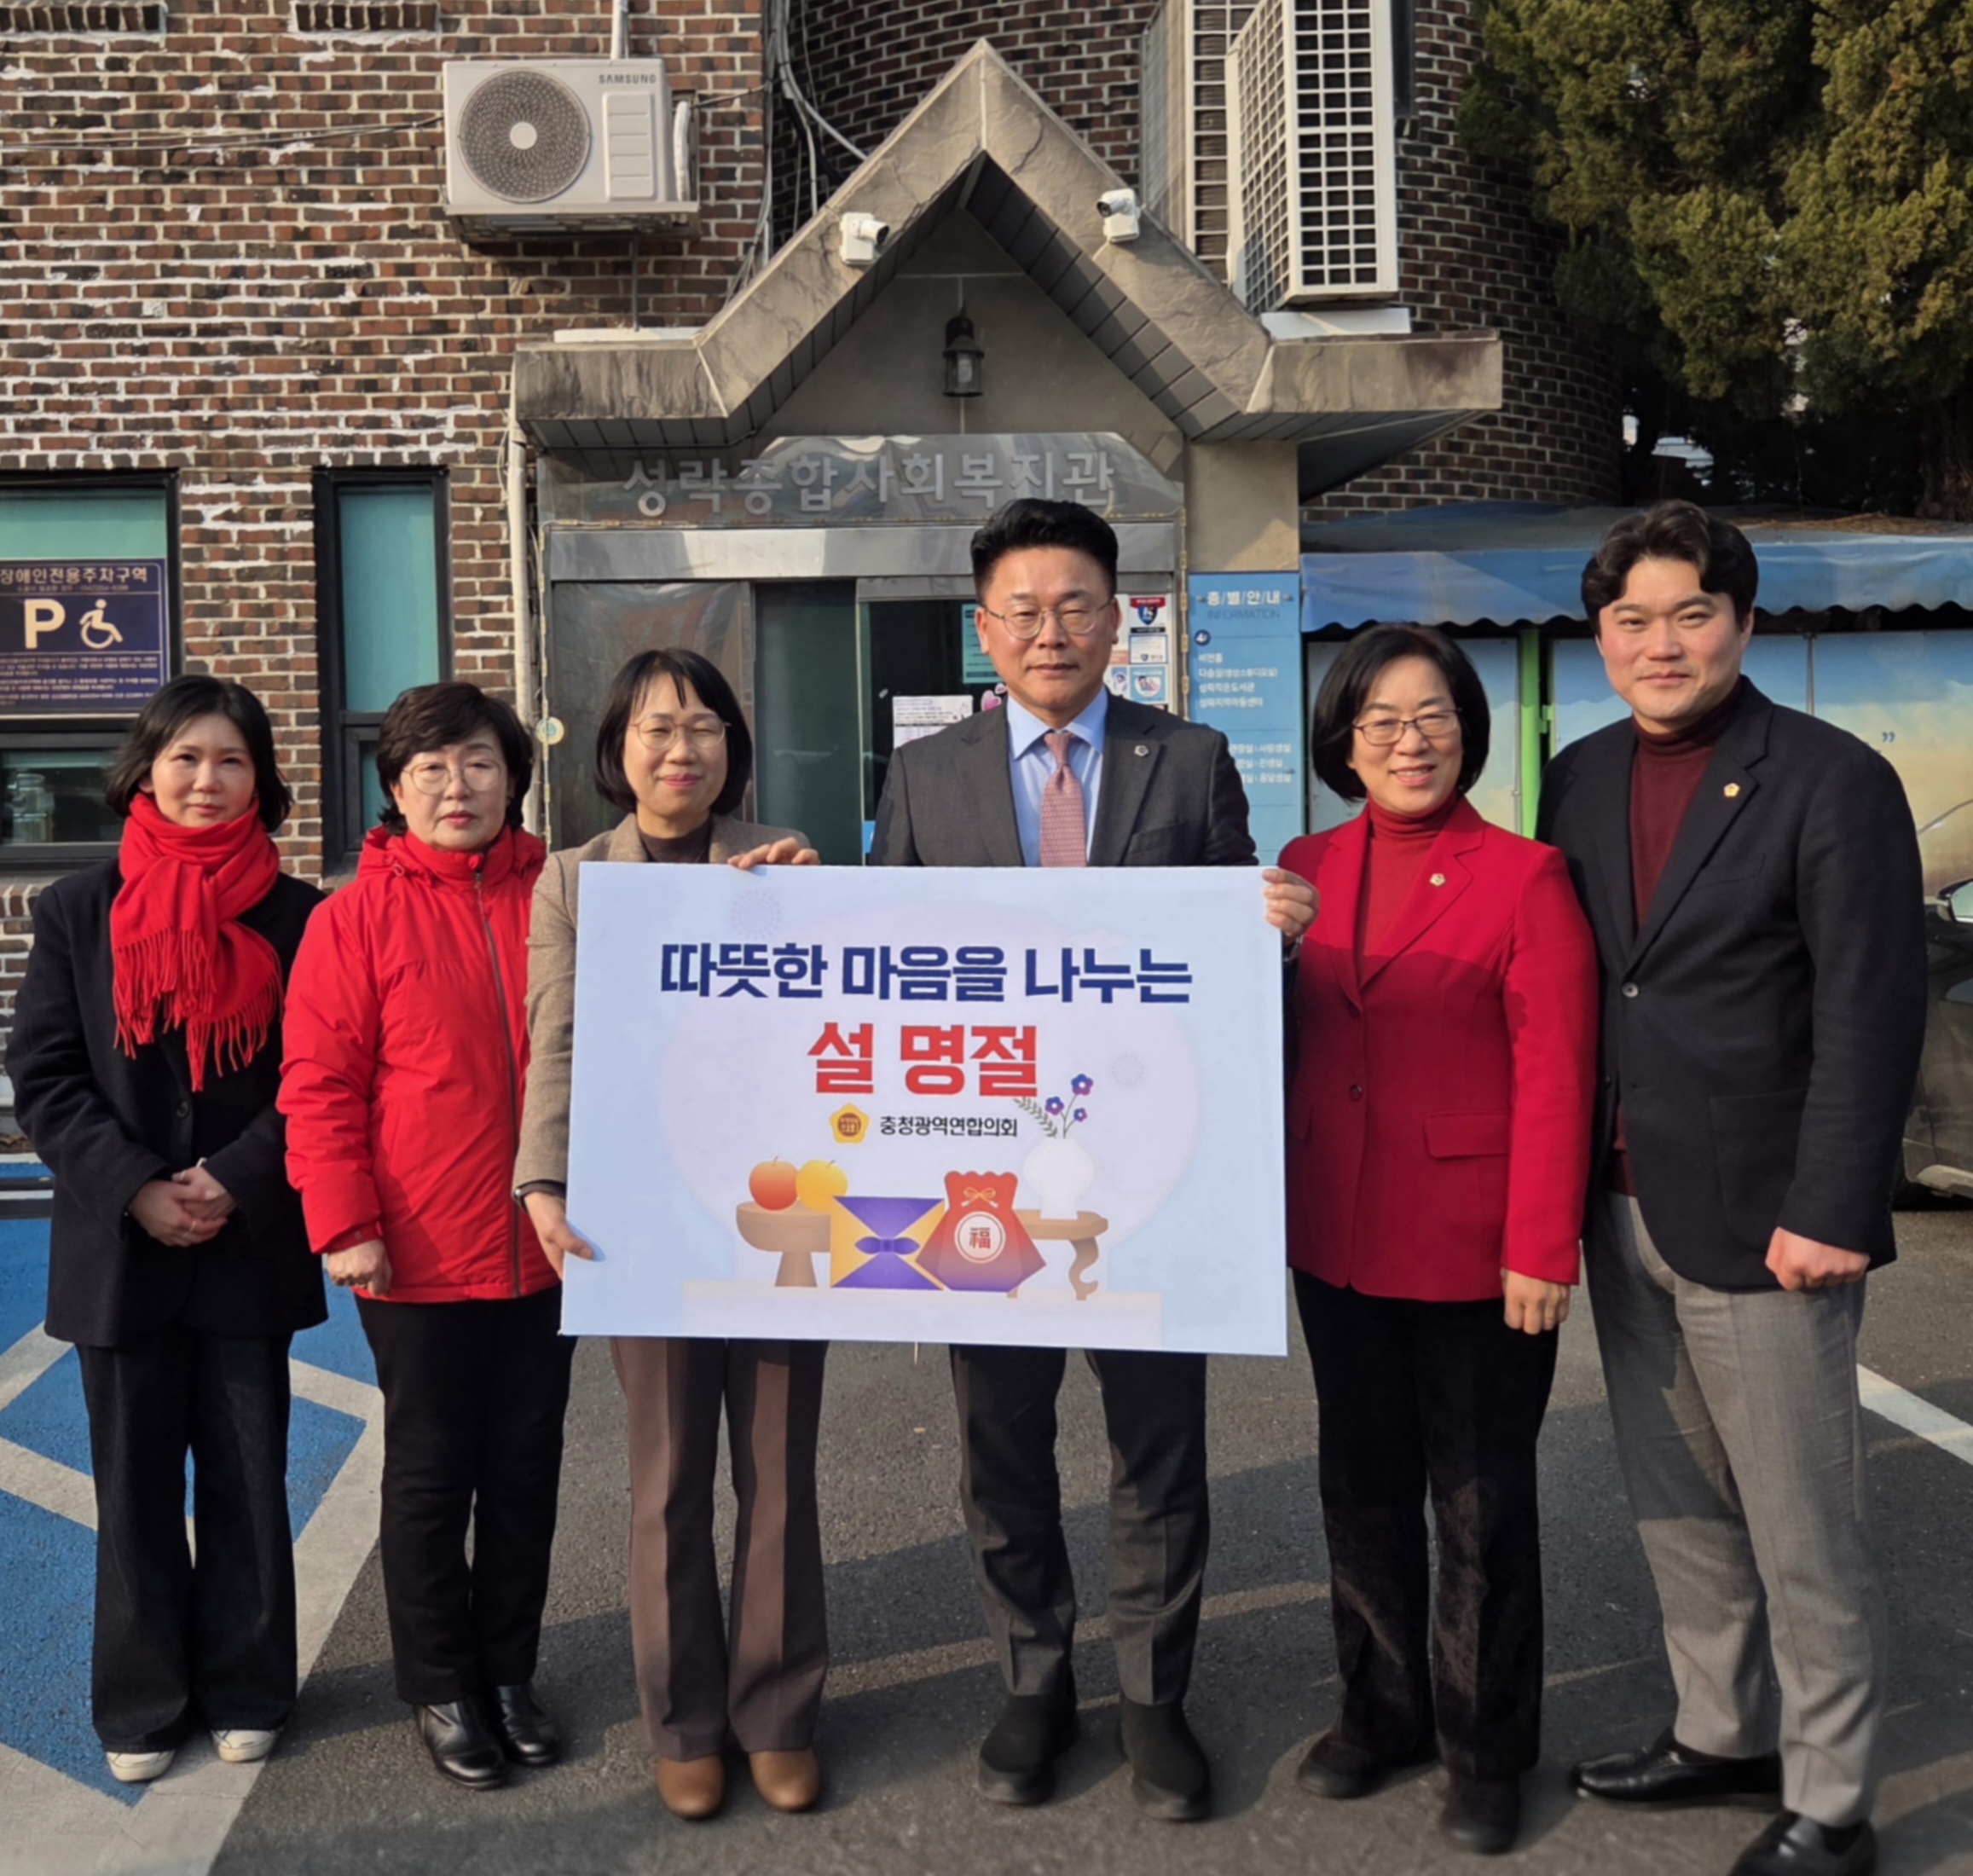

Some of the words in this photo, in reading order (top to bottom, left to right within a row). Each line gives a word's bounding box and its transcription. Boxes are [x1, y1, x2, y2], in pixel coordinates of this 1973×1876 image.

[599, 74, 657, 84] SAMSUNG
[622, 452, 1114, 517] 성락종합사회복지관
[0, 567, 148, 584] 장애인전용주차구역
[24, 599, 66, 649] P
[1207, 608, 1280, 620] INFORMATION
[661, 942, 828, 999] 따뜻한
[842, 945, 1008, 1003] 마음을
[1025, 947, 1193, 1004] 나누는
[808, 1022, 874, 1094] 설
[900, 1025, 1038, 1097] 명절
[880, 1115, 1018, 1138] 충청광역연합의회
[969, 1227, 992, 1251] 福
